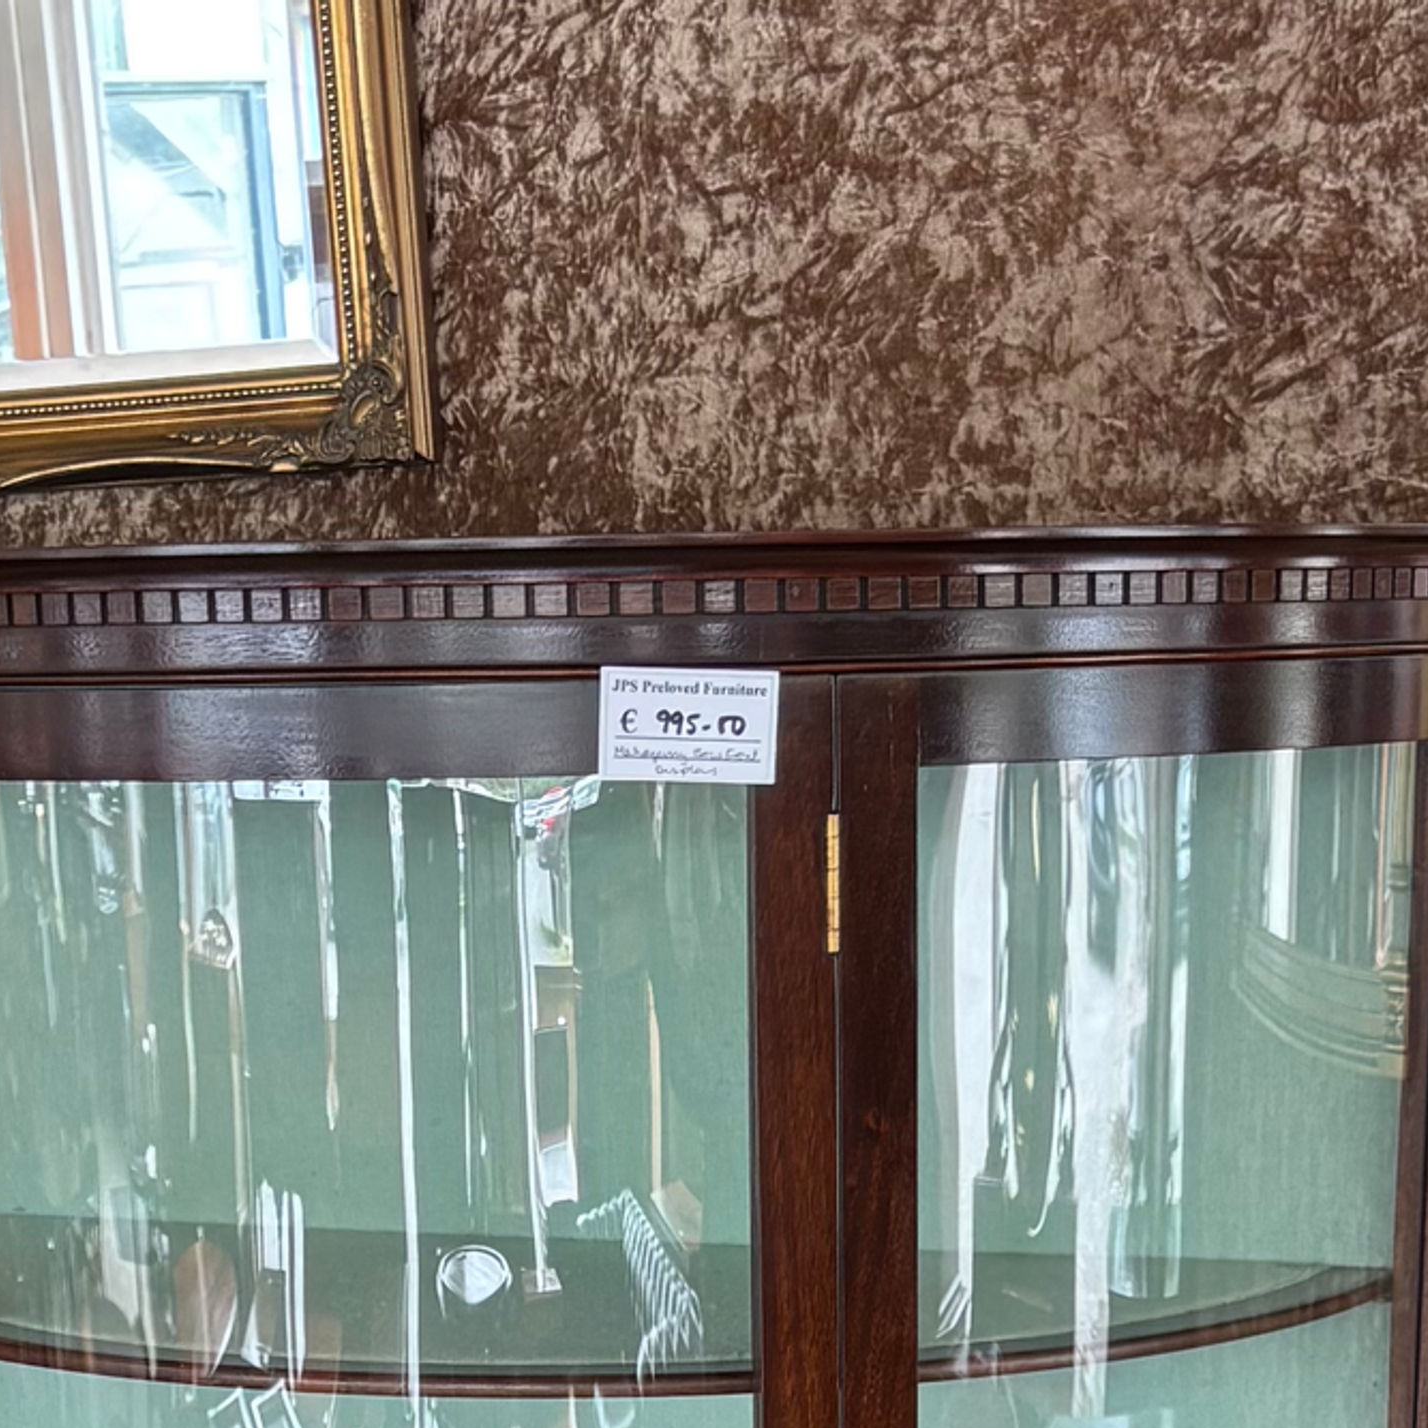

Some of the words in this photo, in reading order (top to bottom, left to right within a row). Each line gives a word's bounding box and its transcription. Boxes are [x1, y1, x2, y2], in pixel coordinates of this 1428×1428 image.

[612, 678, 638, 693] JPS
[642, 680, 700, 695] Preloved
[703, 681, 769, 697] Furniture
[620, 708, 639, 734] €
